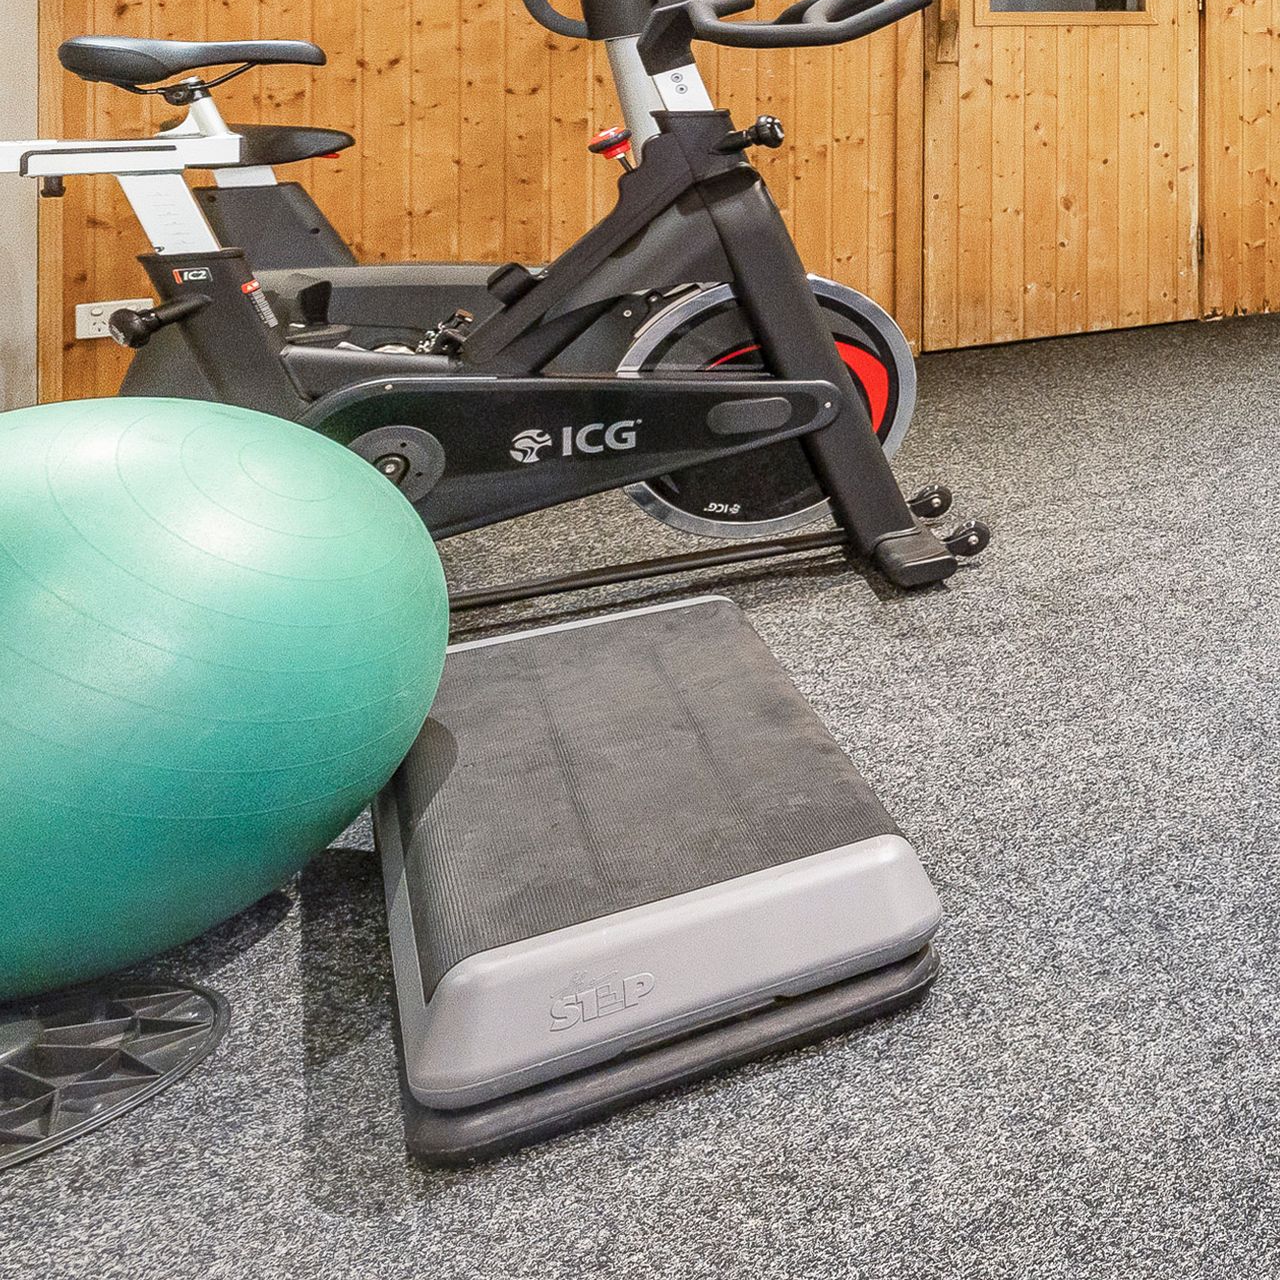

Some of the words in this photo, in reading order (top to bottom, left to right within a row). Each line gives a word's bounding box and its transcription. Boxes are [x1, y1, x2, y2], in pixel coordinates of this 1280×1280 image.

[183, 271, 207, 281] IC2
[562, 420, 638, 457] ICG
[550, 972, 656, 1032] STEP
